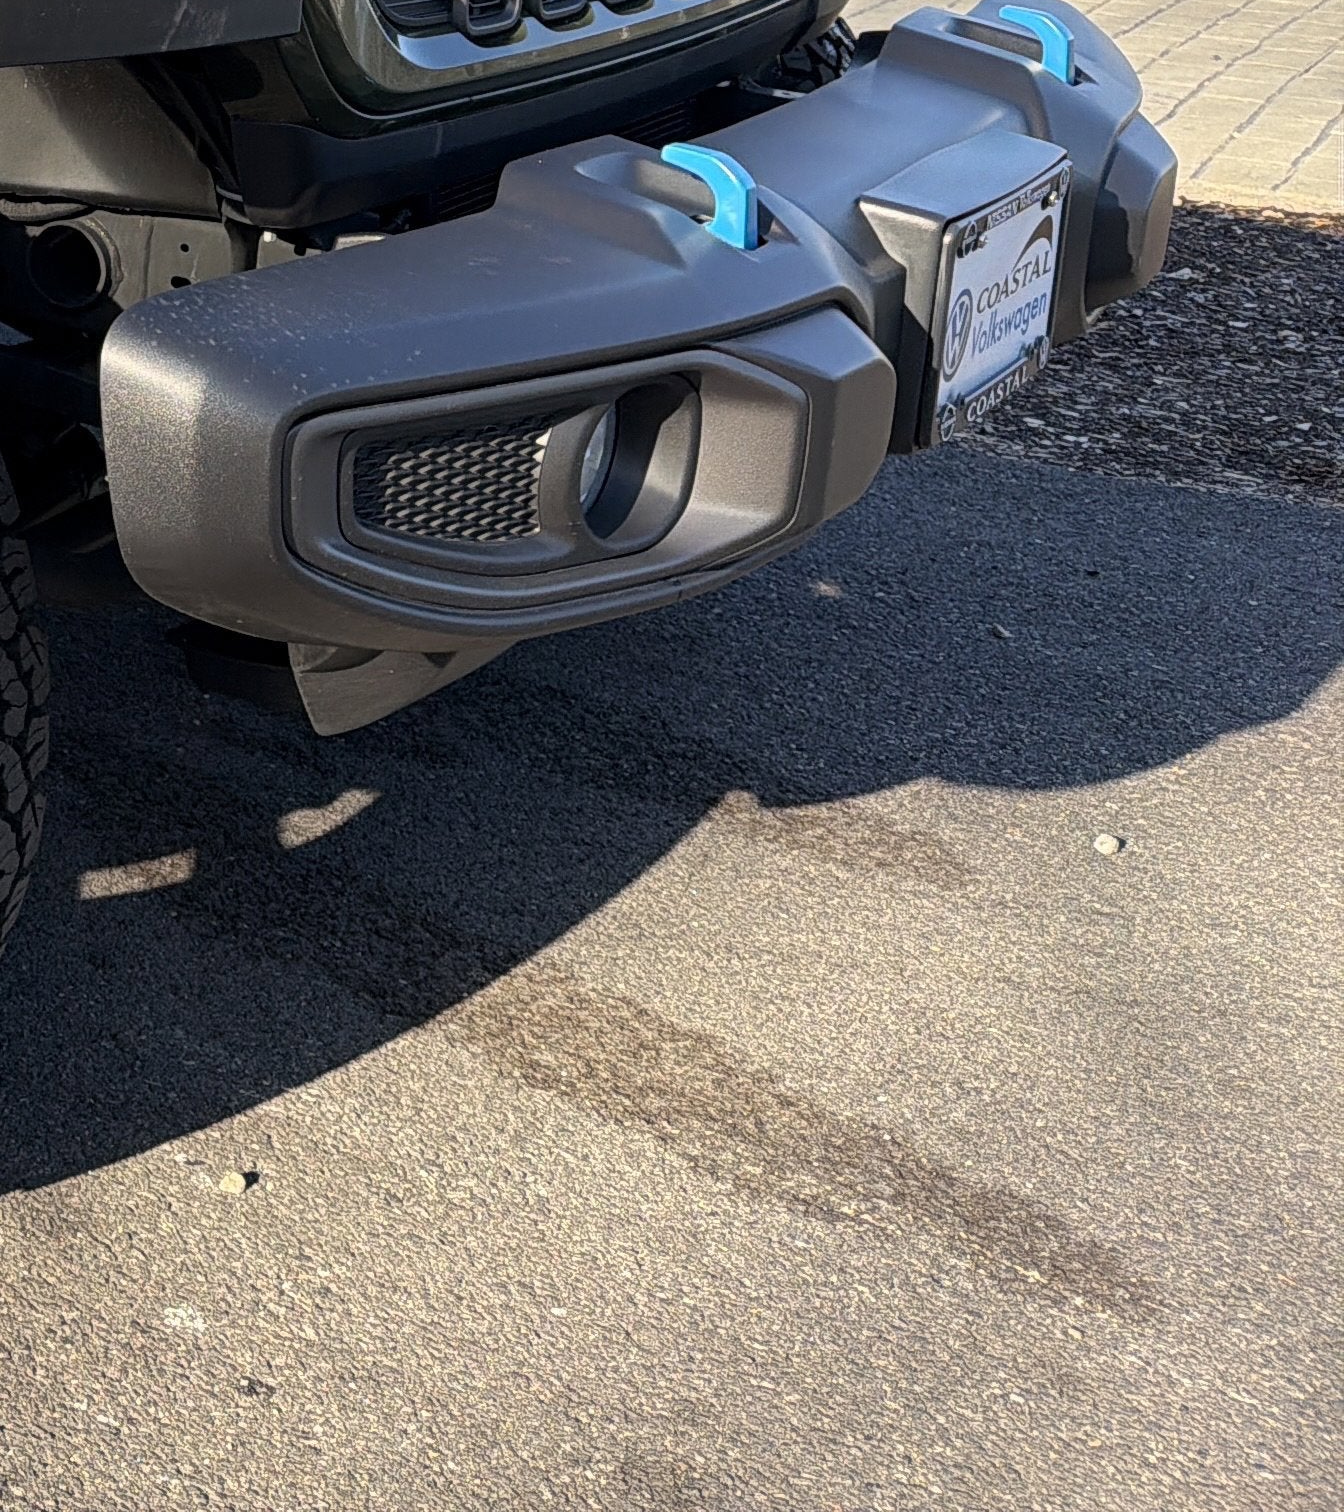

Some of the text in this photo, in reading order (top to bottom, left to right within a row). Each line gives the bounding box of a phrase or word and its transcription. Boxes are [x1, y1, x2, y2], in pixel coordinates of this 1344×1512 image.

[976, 249, 1052, 315] COASTAL
[968, 291, 1048, 359] Volkswagen
[966, 364, 1030, 423] COASTAL
